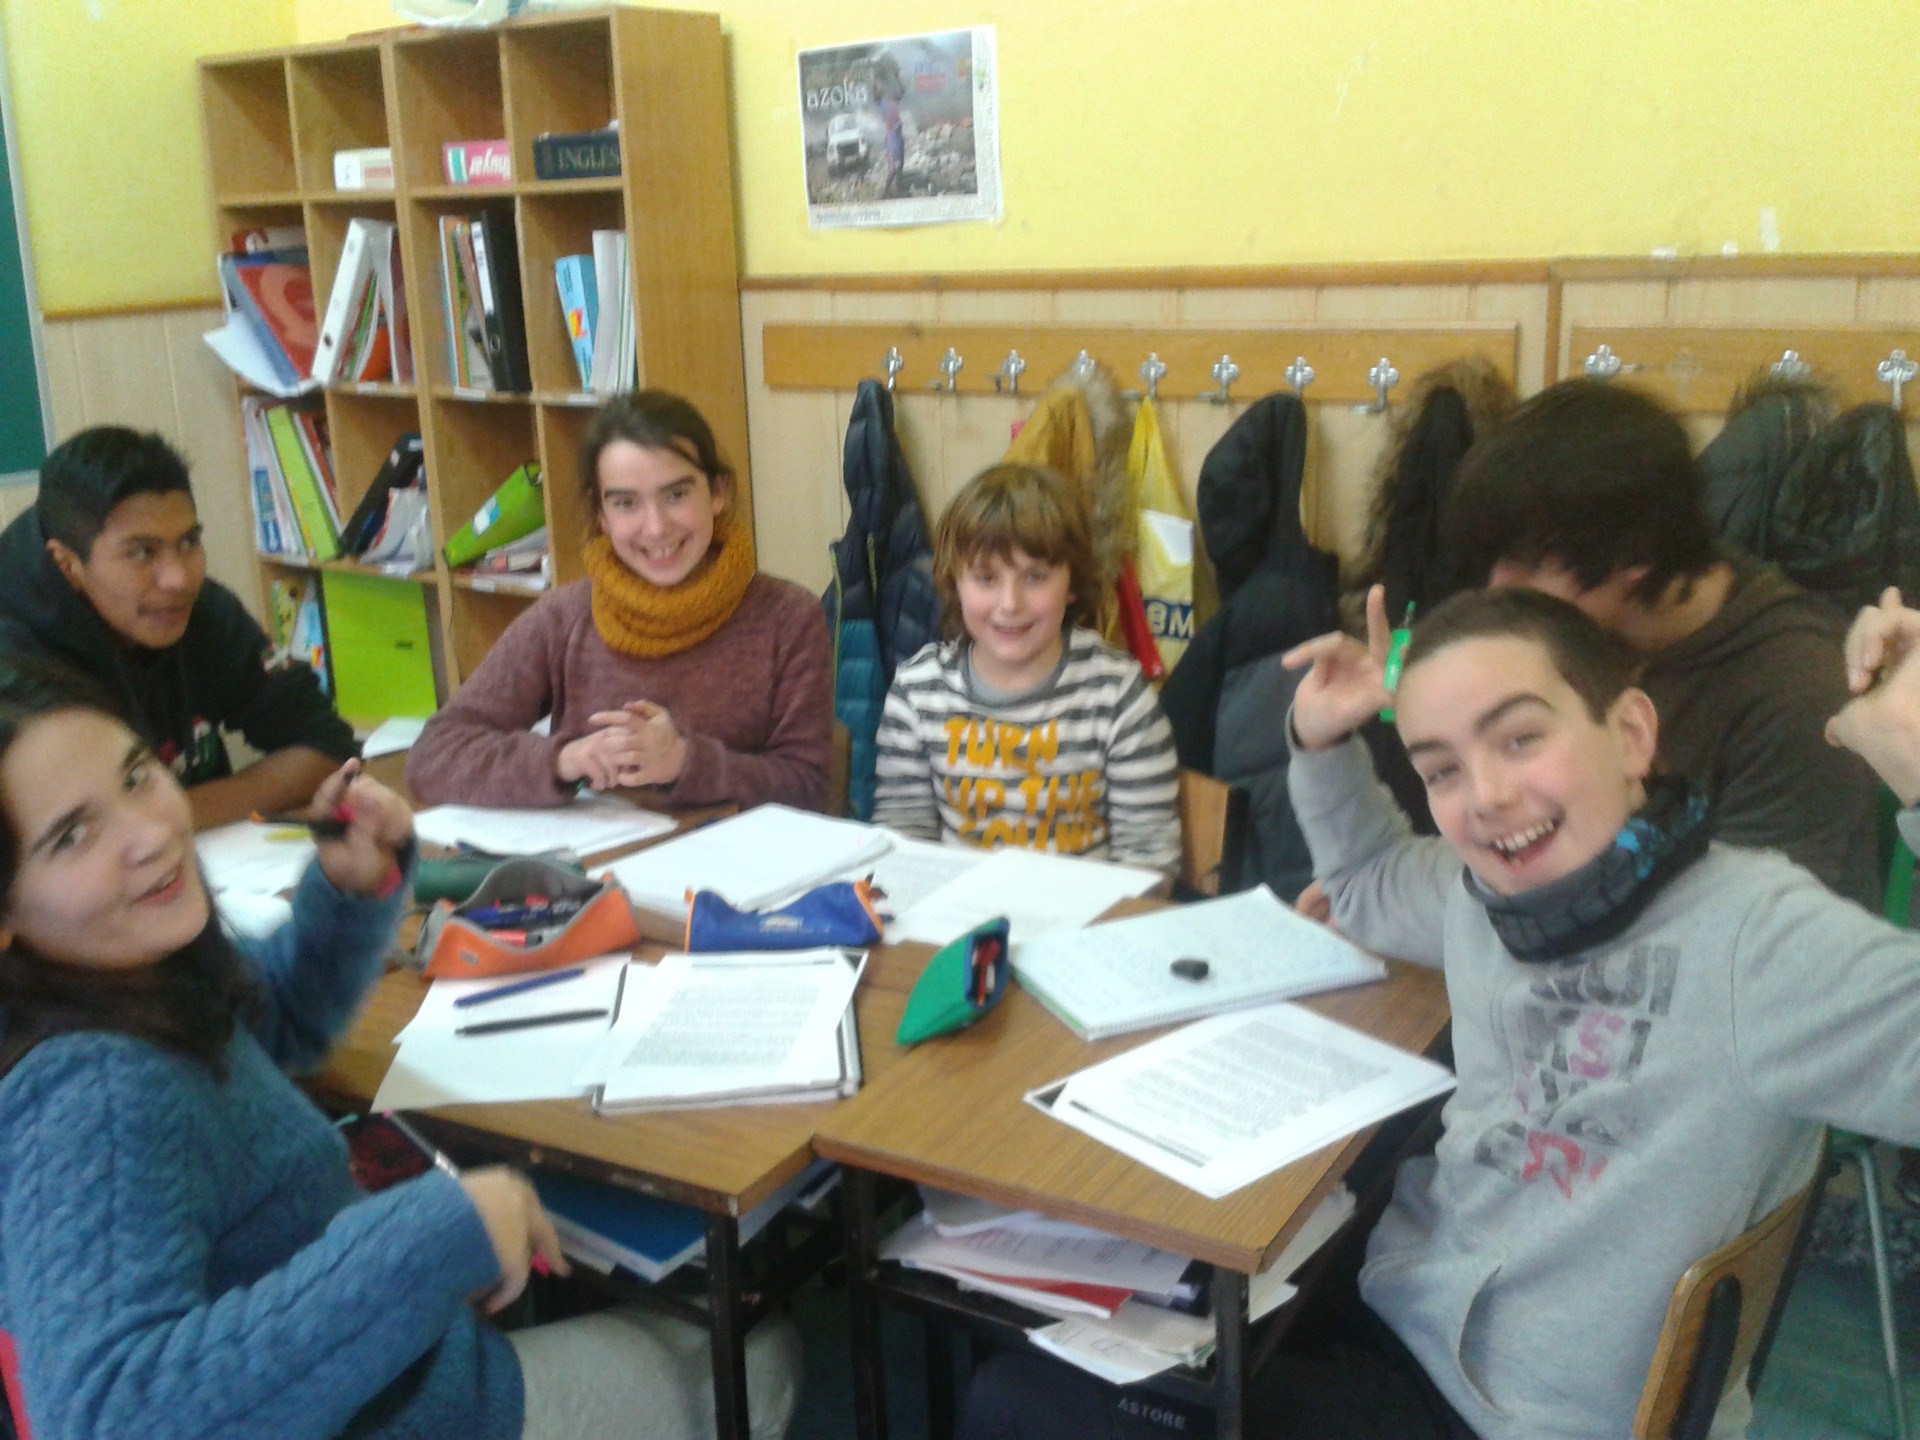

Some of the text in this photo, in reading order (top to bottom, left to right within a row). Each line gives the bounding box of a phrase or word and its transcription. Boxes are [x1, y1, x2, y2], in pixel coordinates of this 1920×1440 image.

[806, 76, 867, 110] azoka
[943, 716, 1060, 769] TURN
[943, 769, 1102, 821] UP THE
